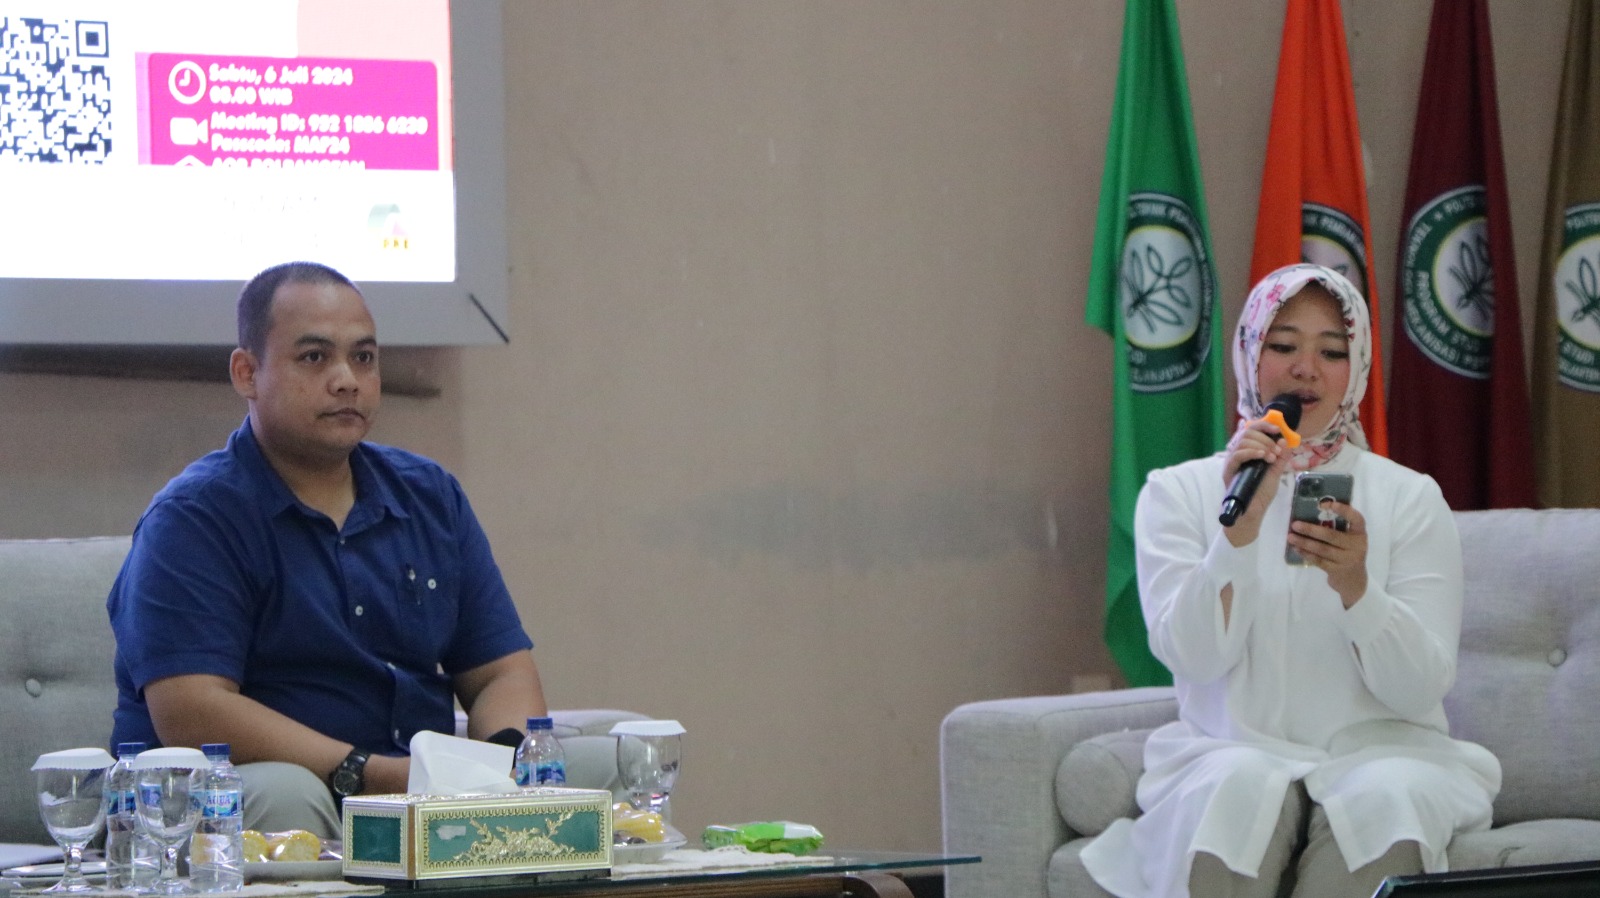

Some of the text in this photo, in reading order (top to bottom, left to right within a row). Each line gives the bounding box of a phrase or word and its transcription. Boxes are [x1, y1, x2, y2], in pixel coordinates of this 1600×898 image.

[264, 65, 277, 84] 6
[279, 65, 309, 84] Juli
[311, 66, 353, 86] 2024
[211, 111, 278, 135] Meeting
[211, 133, 291, 153] Passcode:
[206, 794, 231, 805] AQUA
